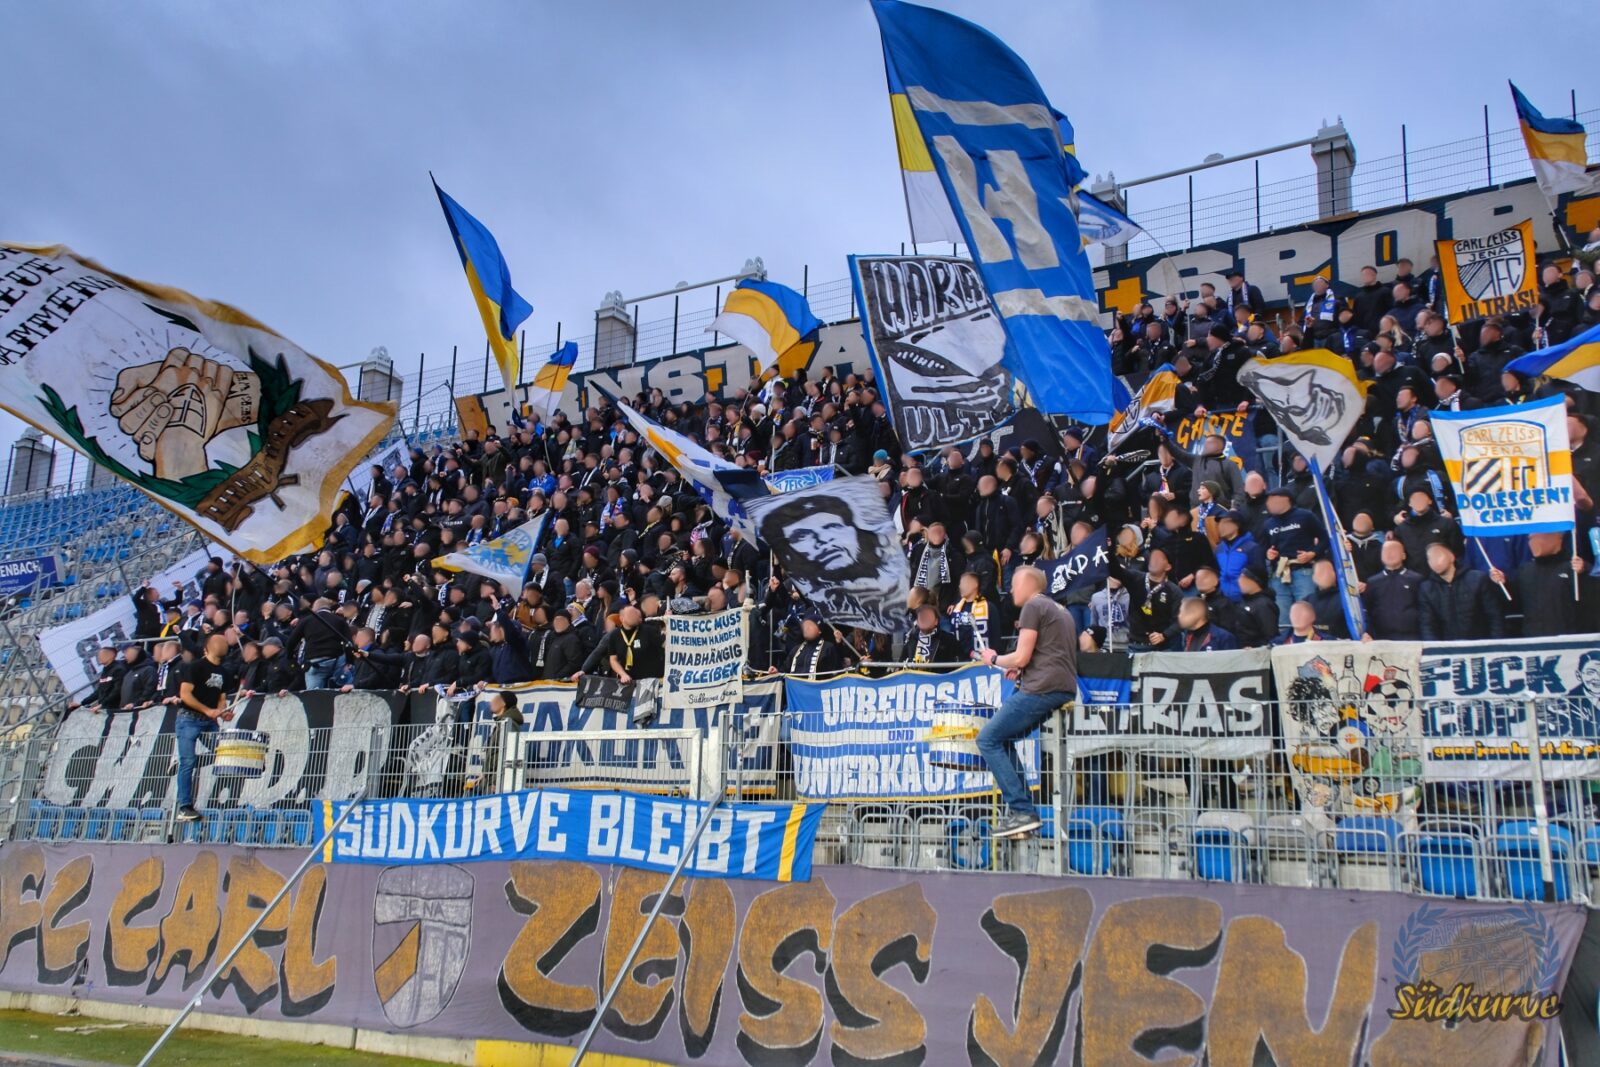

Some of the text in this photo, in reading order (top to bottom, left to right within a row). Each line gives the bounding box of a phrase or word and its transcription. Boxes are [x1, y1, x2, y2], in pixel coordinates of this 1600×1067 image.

[1456, 229, 1519, 253] CARL ZEISS
[1468, 247, 1510, 262] JENA
[0, 257, 64, 318] EUE
[0, 275, 128, 366] AMMEN
[1466, 426, 1536, 443] CARL ZEISS
[1479, 445, 1525, 457] JENA
[1512, 466, 1536, 491] FC
[669, 611, 741, 633] DER FCC MUSS
[670, 627, 741, 647] IN SEINEM HANDELN
[669, 644, 742, 667] UNABHÄNGIG
[683, 662, 741, 685] BLEIBEN
[1420, 654, 1567, 697] FUCK
[820, 673, 1002, 726] UNBEUGSAM
[1421, 700, 1574, 737] COPS
[470, 695, 777, 770] SDKURVE
[888, 730, 914, 742] UND
[337, 792, 776, 874] SÜDKURVE BLEIBT
[398, 902, 446, 919] JENA
[0, 848, 337, 1017] FC CARL
[496, 861, 938, 1067] ZEISS
